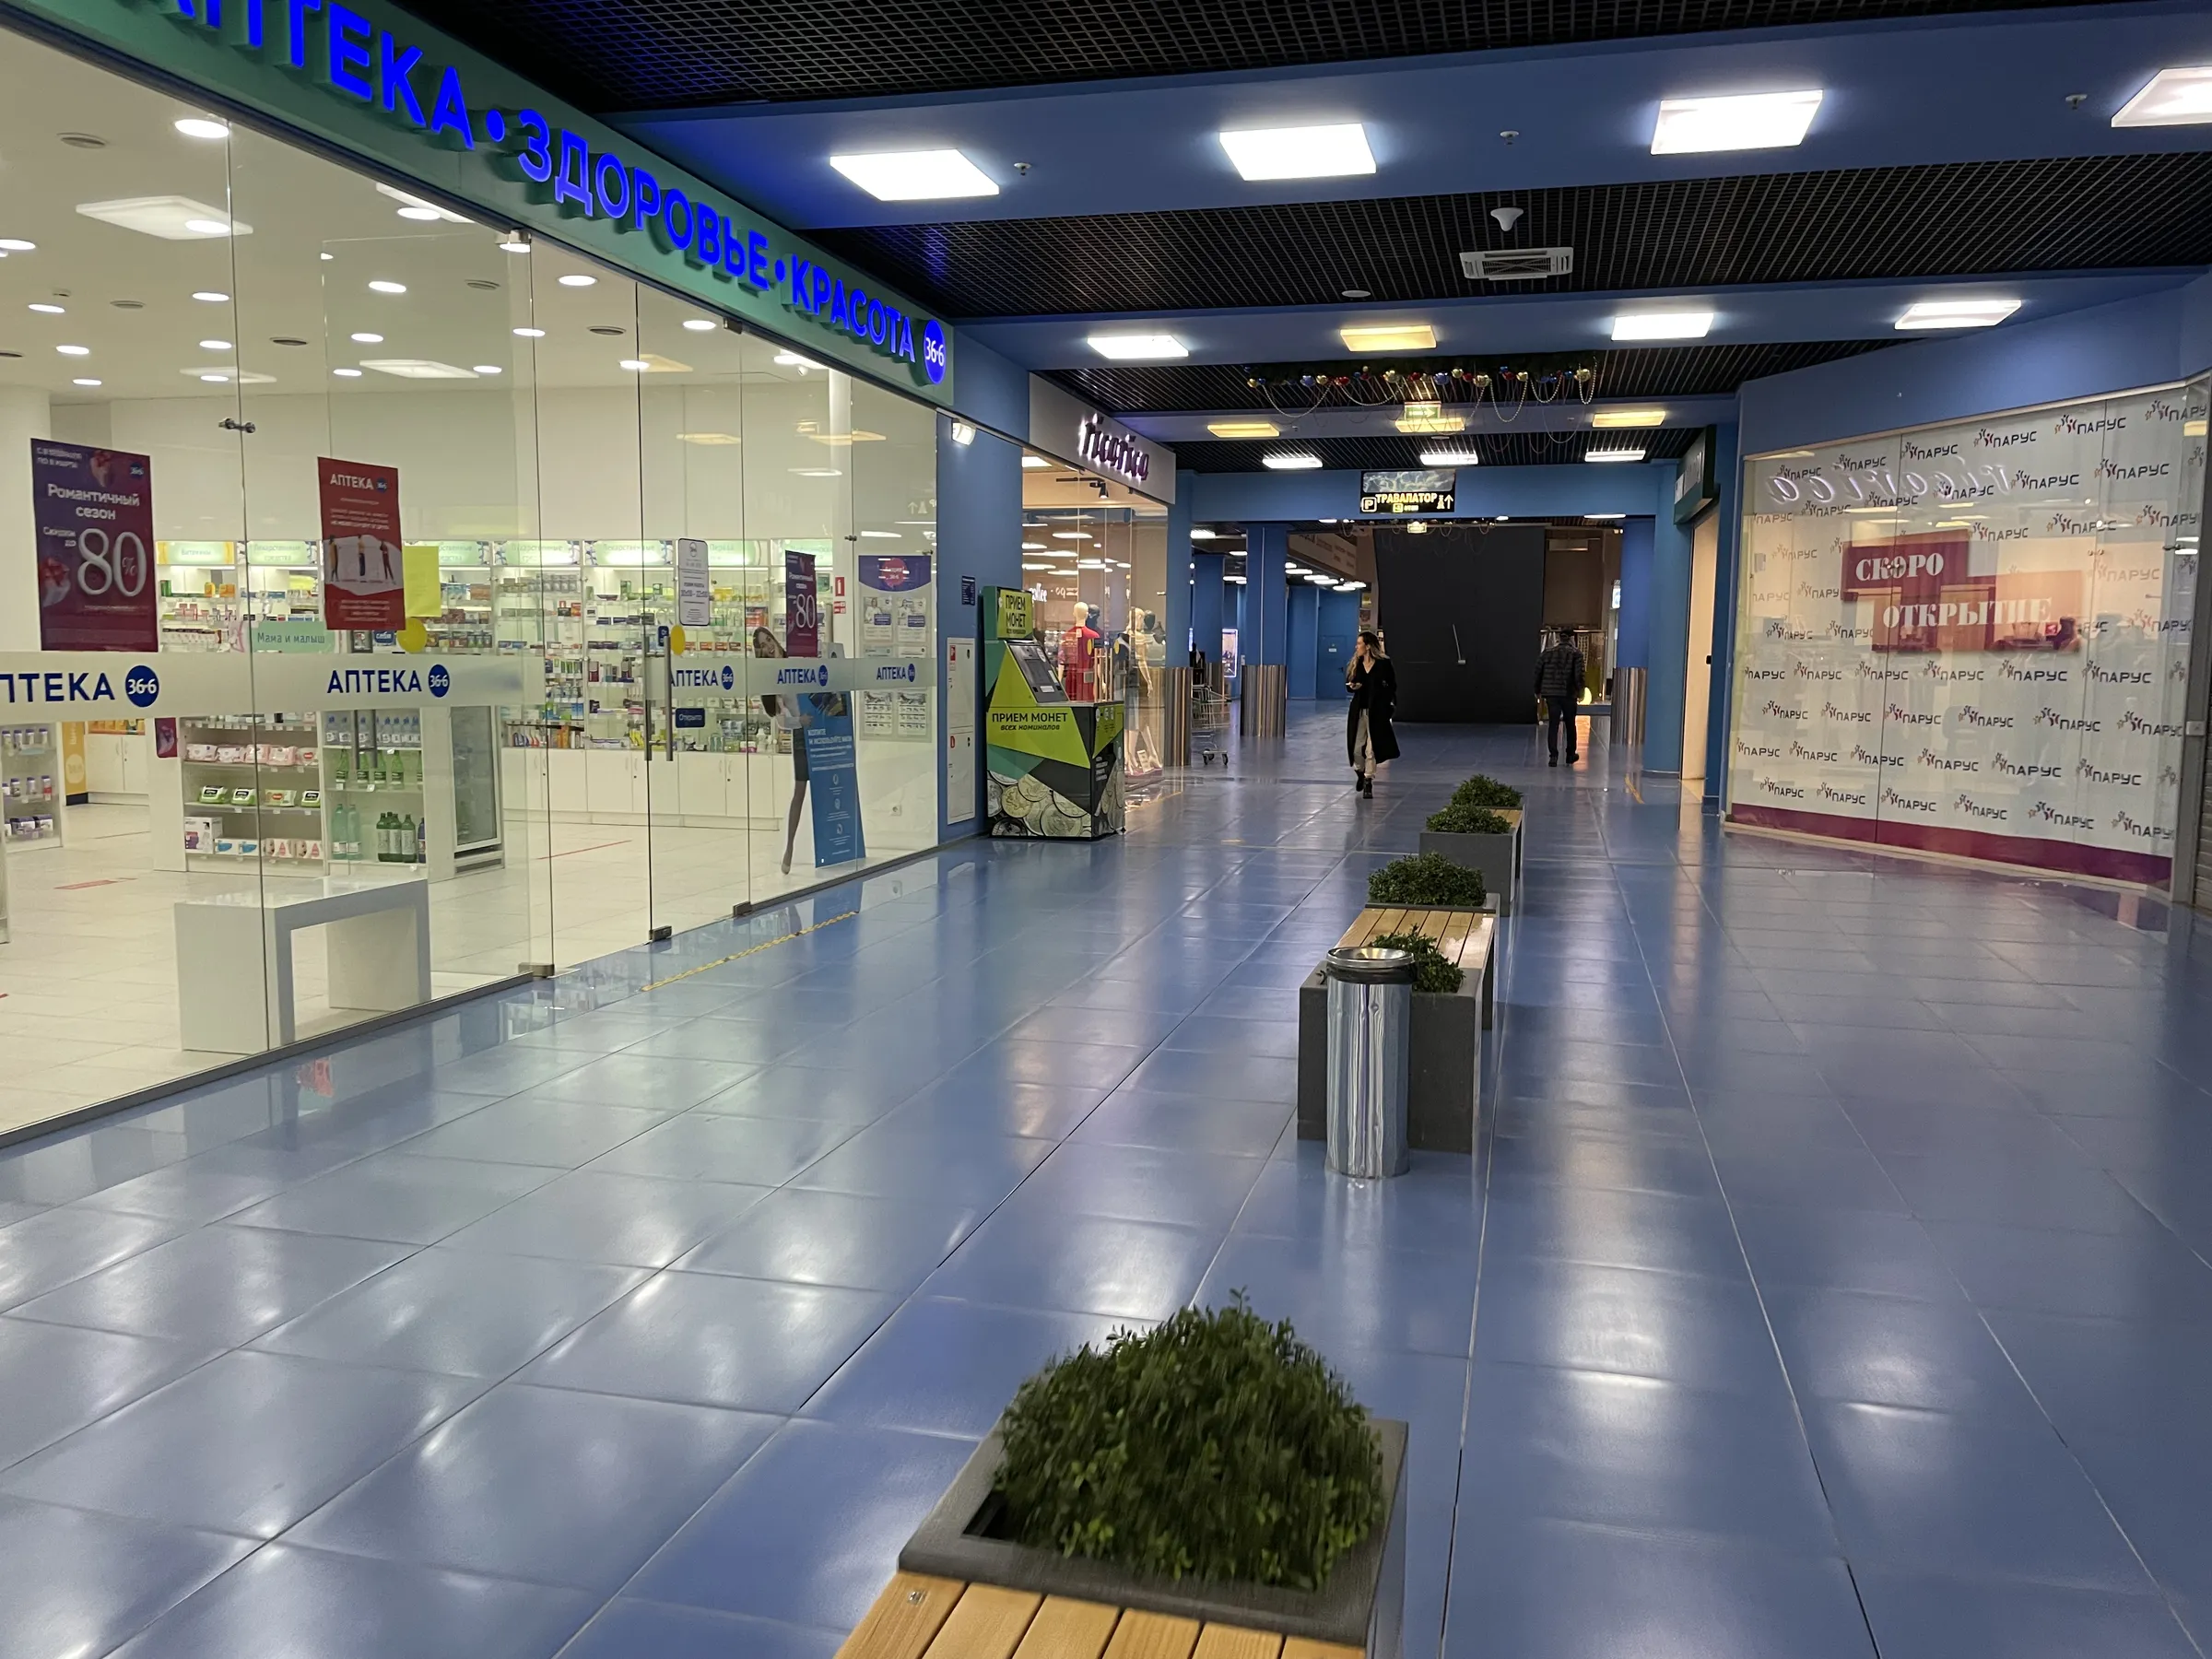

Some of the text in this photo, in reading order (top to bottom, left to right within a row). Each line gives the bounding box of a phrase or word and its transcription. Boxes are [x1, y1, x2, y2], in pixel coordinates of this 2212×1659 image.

[177, 0, 476, 150] ТЕКА
[518, 109, 770, 291] ЗДОРОВЬЕ
[792, 254, 916, 362] КРАСОТА
[1791, 404, 2207, 480] ПАРУС ПАРУС ПАРУС ПАРУС ПАРУС ПАРУ
[330, 473, 374, 490] АПТЕКА
[48, 484, 140, 507] Романтичный
[1375, 492, 1438, 504] ТРАВАЛАТОР
[1756, 464, 2171, 524] ПАРУС ПАРУС ПАРУС ПАРУС ПАРУС ПАРУС
[76, 506, 116, 520] сезон
[1988, 528, 2030, 542] ПАРУС
[2159, 512, 2200, 527] ПАРУ
[77, 528, 147, 597] 80
[1855, 553, 1945, 582] СКОРО
[1812, 588, 1840, 598] ПАРУ
[2107, 569, 2160, 582] ПАРУС
[795, 594, 816, 629] 80
[1006, 594, 1026, 611] ПРИЕМ
[1883, 597, 2053, 629] ОТКРЫТИЕ
[1006, 613, 1027, 628] МОНЕТ
[257, 632, 325, 644] Мама и малыш
[1784, 630, 1814, 640] ПАРУС
[327, 670, 422, 693] АПТЕКА
[777, 668, 817, 685] АПТЕКА
[876, 666, 907, 680] АПТЕКА
[1747, 670, 2152, 683] ПАРУС ПАРУС ПАРУС ПАРУС ПАРУС ПАРУС
[0, 673, 115, 703] ПТЕКА
[992, 712, 1068, 723] ПРИЕМ МОНЕТ
[1780, 710, 1809, 720] ПАРУС
[1836, 712, 1872, 722] ПАРУС
[1903, 713, 1942, 724] ПАРУС
[1977, 716, 2014, 727] ПАРУС
[2059, 719, 2101, 732] ПАРУС
[1744, 747, 2143, 785] ПАРУС ПАРУС ПАРУС ПАРУС ПАРУС ПАРУС
[1774, 786, 2175, 840] ПАРУС ПАРУС ПАРУС ПАРУС ПАРУС ПАРУ
